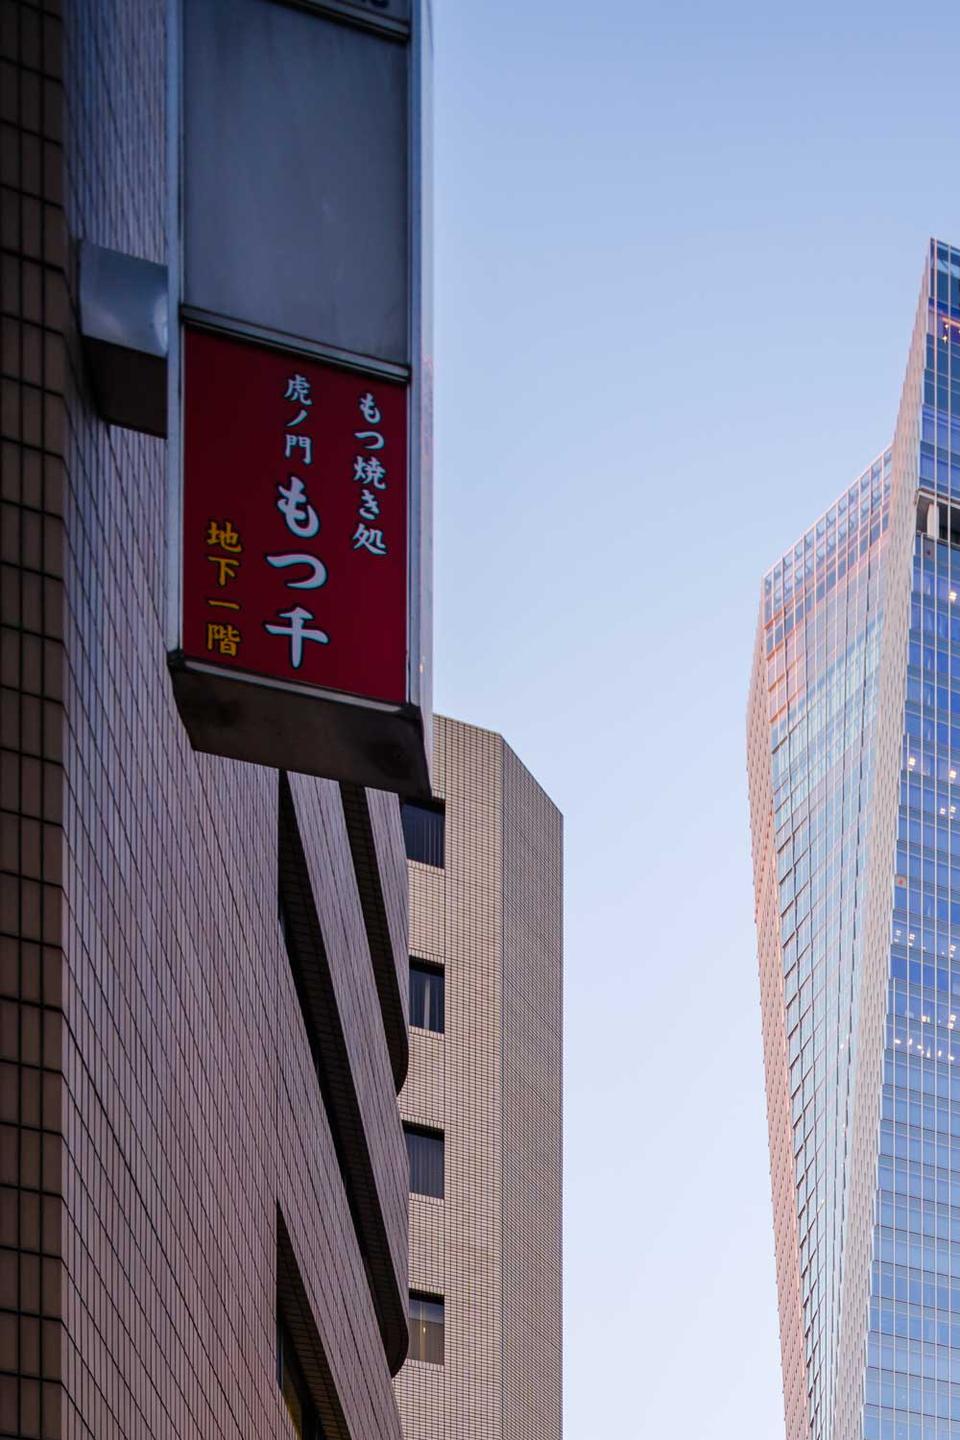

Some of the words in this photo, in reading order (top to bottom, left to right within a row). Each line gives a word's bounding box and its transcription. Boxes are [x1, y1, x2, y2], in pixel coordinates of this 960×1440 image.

[284, 374, 313, 465] 虎ノ門
[354, 393, 388, 556] もつ焼き処
[207, 521, 242, 657] 地下一階
[265, 476, 329, 669] もつ千
